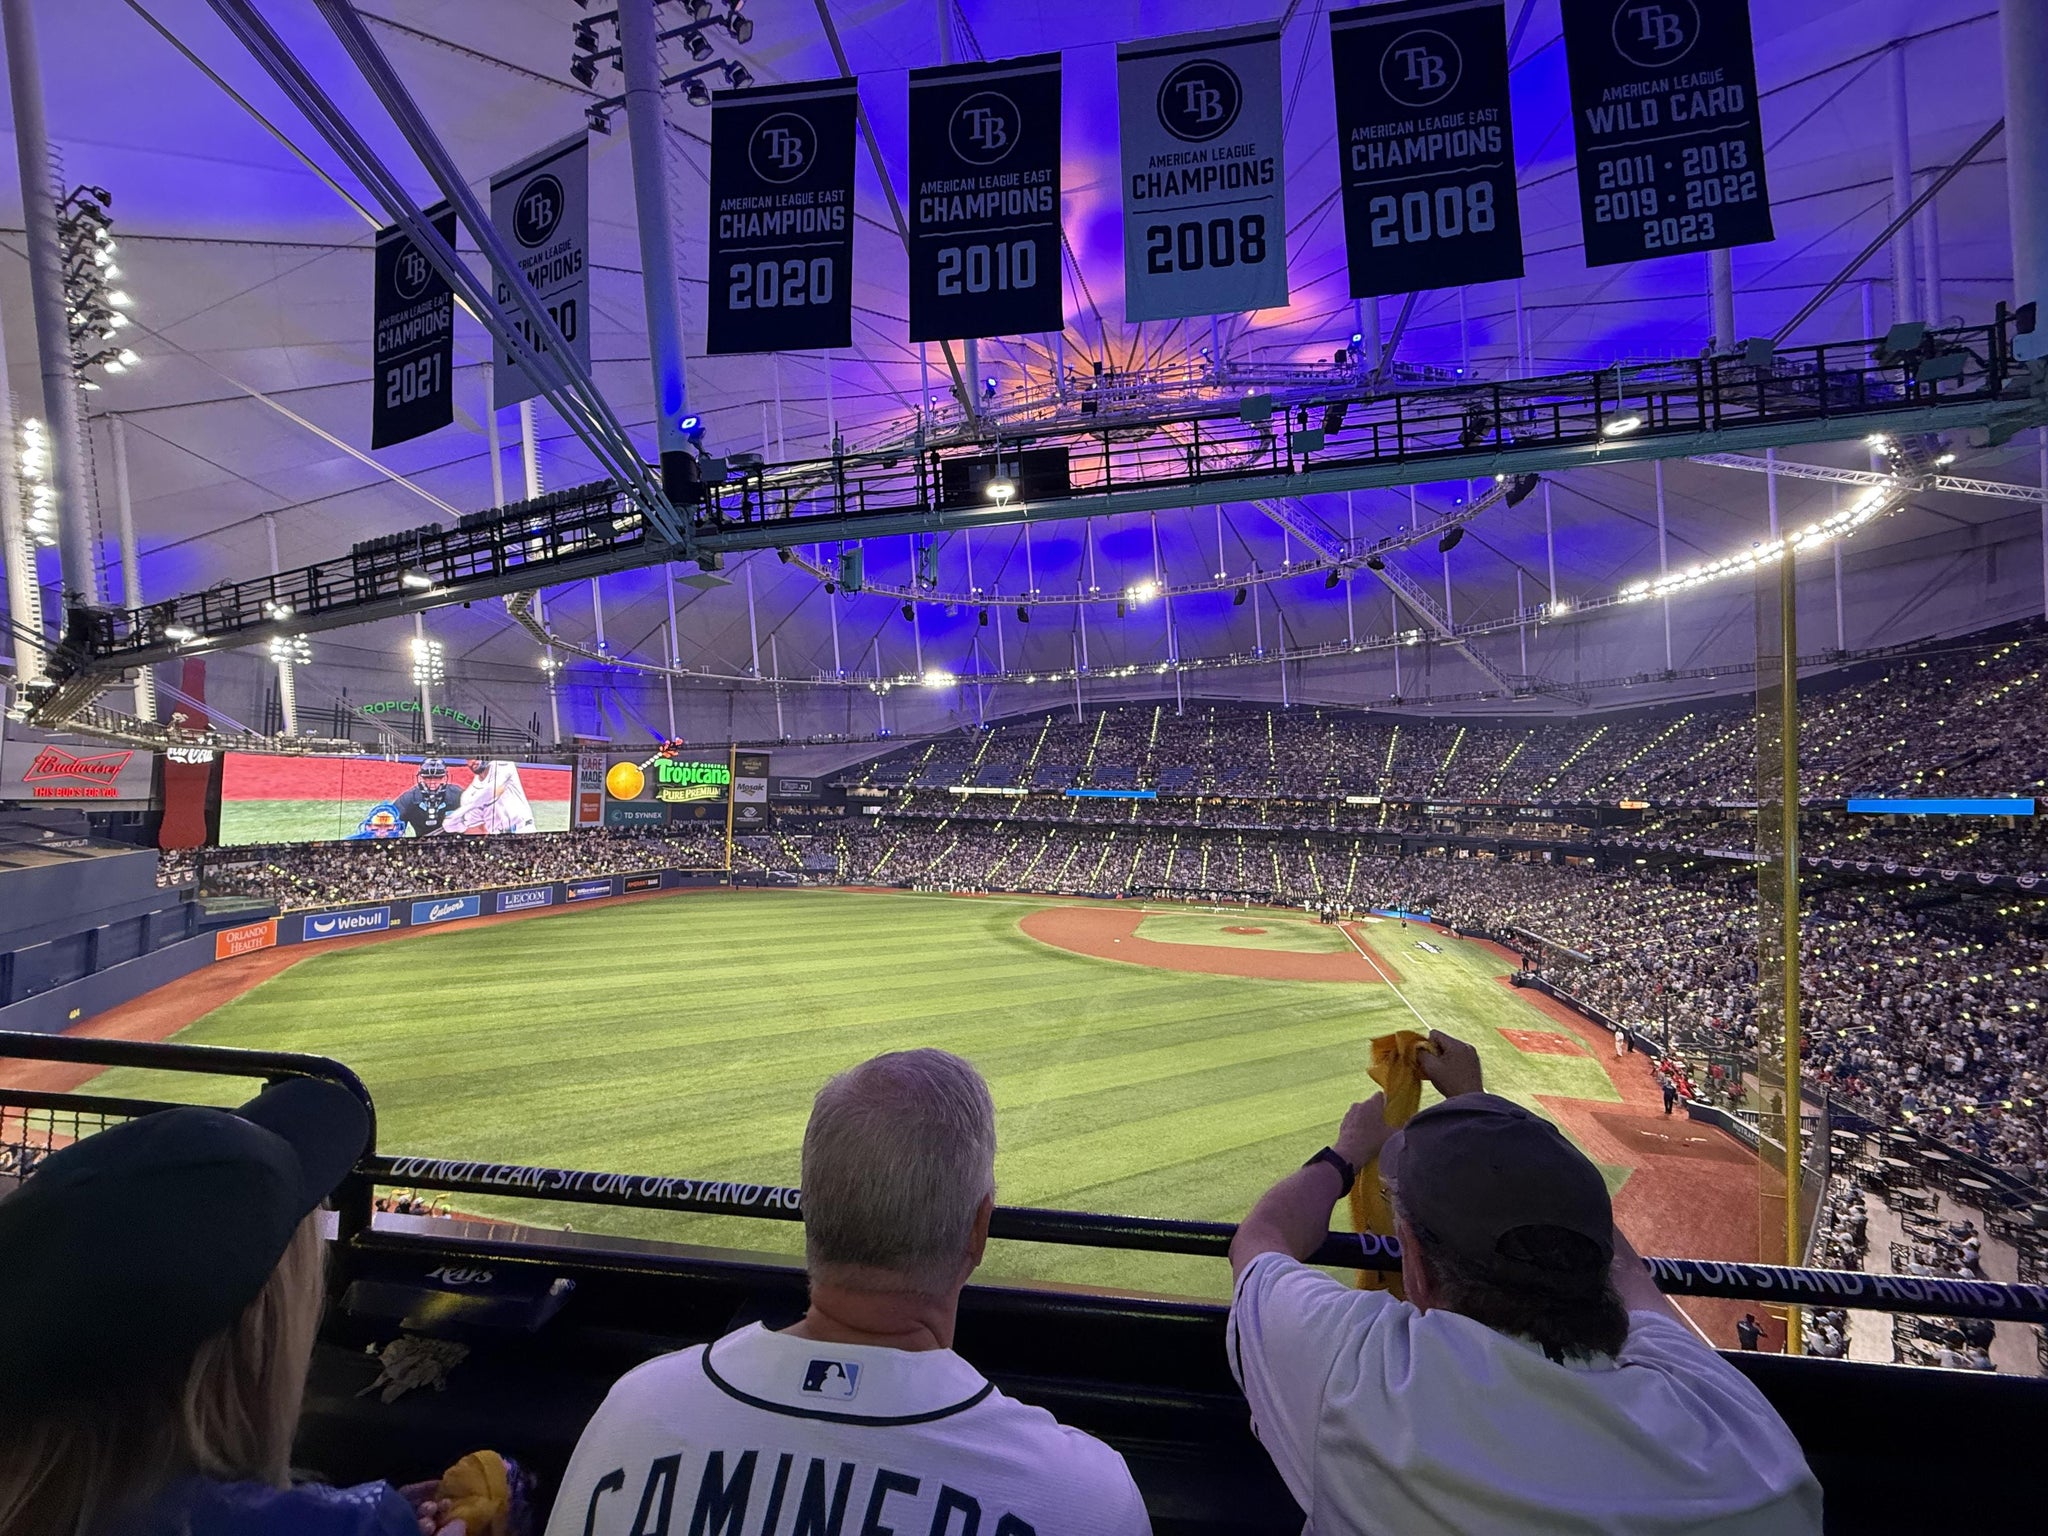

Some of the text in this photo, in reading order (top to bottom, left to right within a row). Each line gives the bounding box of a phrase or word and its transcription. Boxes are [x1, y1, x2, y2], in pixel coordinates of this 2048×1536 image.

[1602, 68, 1724, 102] AMERICAN LEAGUE
[1351, 108, 1498, 142] AMERICAN LEAGUE EAST
[1585, 84, 1744, 134] WILD CARD
[1149, 143, 1256, 169] AMERICAN LEAGUE
[1351, 126, 1502, 171] CHAMPIONS
[1598, 140, 1748, 189] 2011 2013
[920, 169, 1052, 195] AMERICAN LEAGUE EAST
[1132, 157, 1274, 200] CHAMPIONS
[720, 190, 845, 211] AMERICAN LEAGUE EAST
[920, 186, 1053, 223] CHAMPIONS
[1594, 170, 1757, 222] 2019 2022
[719, 206, 845, 239] CHAMPIONS
[1369, 181, 1495, 247] 2008
[1643, 212, 1715, 249] 2023
[518, 238, 572, 271] ERICAN LEAGUE
[1146, 214, 1266, 274] 2008
[498, 249, 582, 305] CMPIONS
[729, 257, 833, 309] 2020
[937, 239, 1037, 296] 2010
[378, 307, 409, 330] AMERICAN
[410, 299, 433, 319] LEAGUE
[378, 305, 450, 353] CHAMPIONS
[387, 353, 441, 409] 2021
[353, 701, 481, 731] TROPICAA FIELD
[34, 754, 121, 776] Budweiser
[581, 771, 602, 782] MADE
[582, 758, 602, 770] CARE
[654, 758, 730, 786] Tropicana
[33, 787, 54, 798] THIS
[56, 787, 82, 798] BUD'S
[84, 788, 100, 798] FOR
[663, 787, 721, 800] PURE PREMIUM
[736, 783, 765, 791] Mosaic
[634, 811, 662, 819] SYNNEX
[429, 899, 465, 920] Culver's
[505, 891, 545, 905] LECOM
[226, 925, 268, 943] ORLANDO
[338, 912, 382, 930] Webull
[230, 936, 264, 953] HEALTH
[390, 1157, 429, 1178] DO
[429, 1160, 478, 1182] NOT
[481, 1163, 547, 1192] LEAN,
[550, 1170, 590, 1191] SIT
[592, 1173, 634, 1199] ON,
[640, 1176, 678, 1199] OR
[678, 1179, 763, 1205] STAND
[1359, 1230, 1404, 1258] DO
[1693, 1260, 1749, 1286] OR
[1755, 1264, 1864, 1295] STAND
[1872, 1275, 2024, 1309] AGAINST
[583, 1450, 1038, 1536] CAMINE
